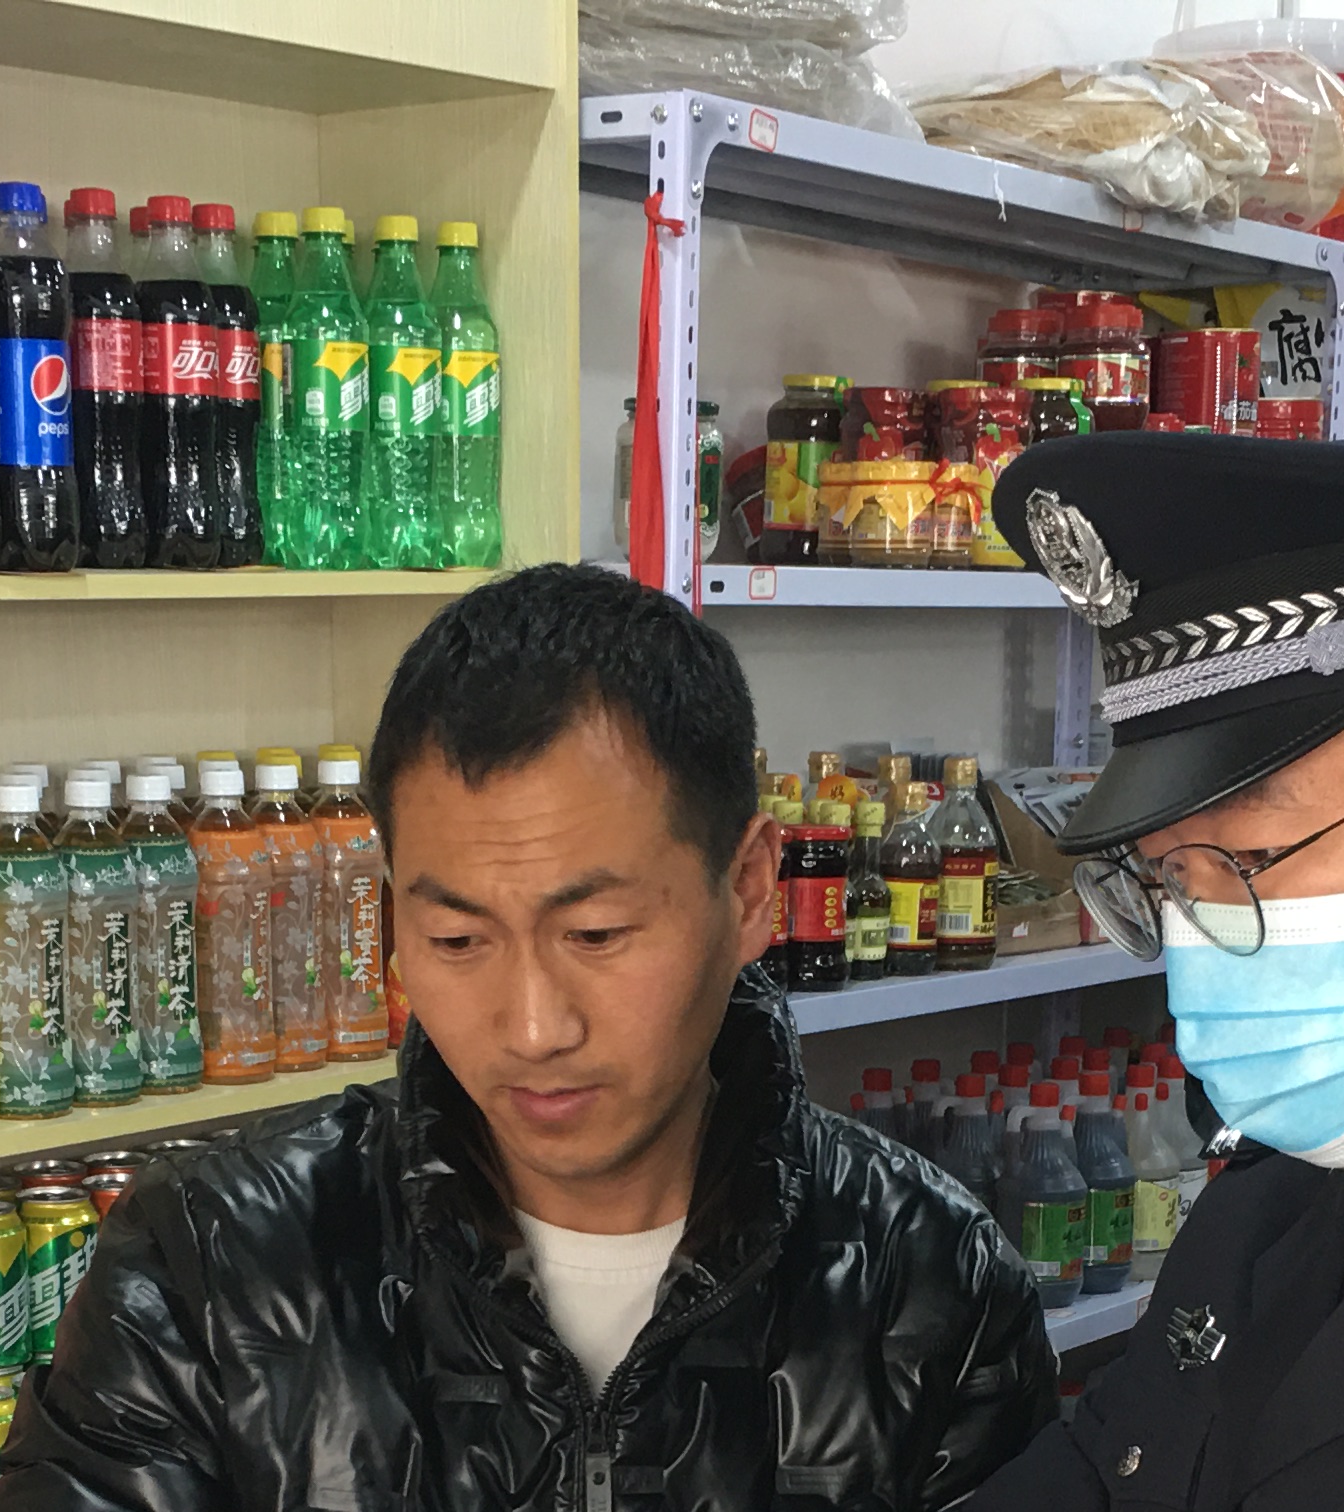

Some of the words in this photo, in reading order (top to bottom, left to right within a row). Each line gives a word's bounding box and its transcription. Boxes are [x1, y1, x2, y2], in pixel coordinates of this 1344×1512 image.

[1268, 309, 1325, 386] 腐
[38, 421, 70, 438] peps
[97, 911, 132, 1035] 茉莉清茶
[162, 900, 196, 1023] 茉莉清茶
